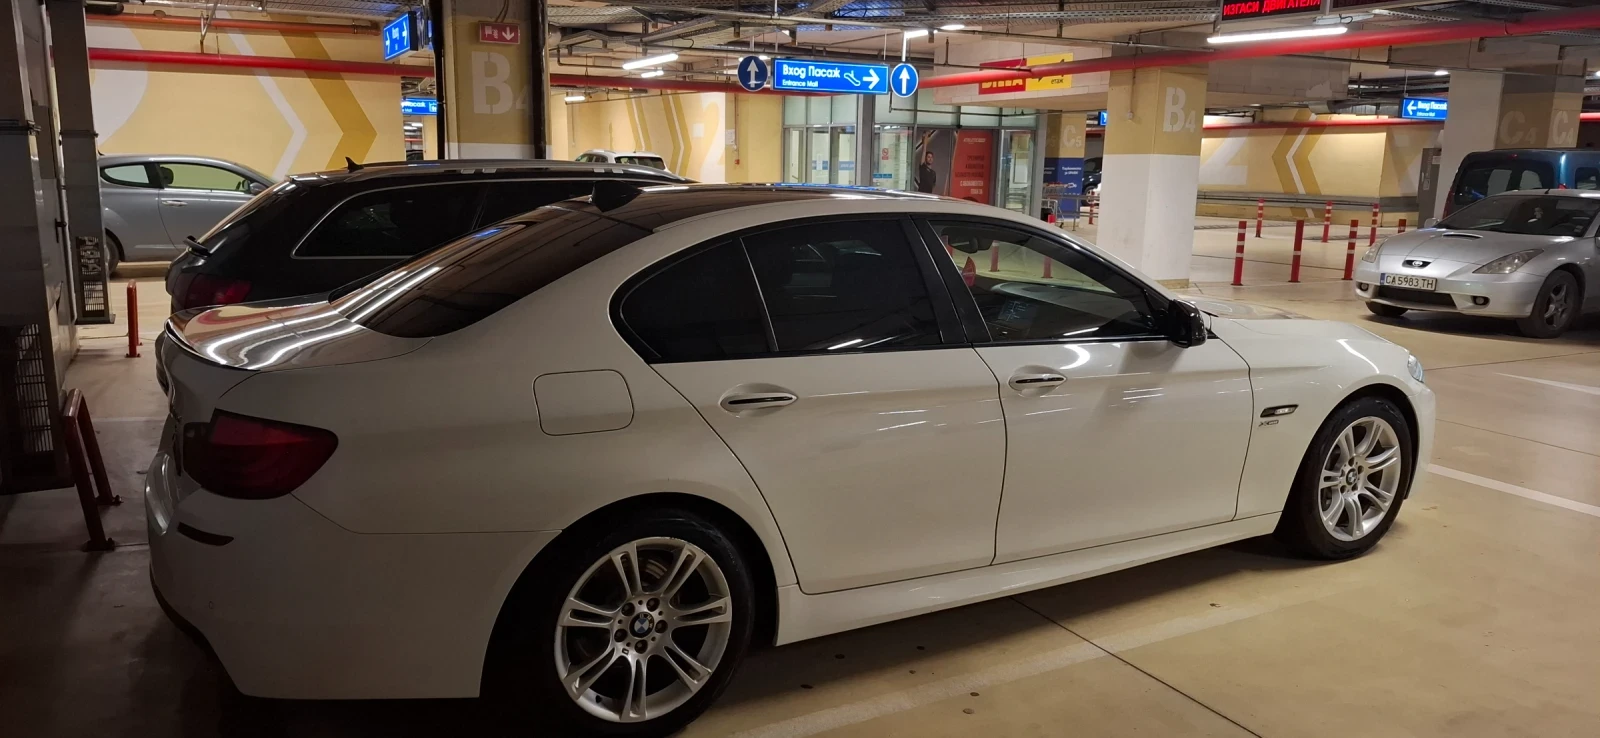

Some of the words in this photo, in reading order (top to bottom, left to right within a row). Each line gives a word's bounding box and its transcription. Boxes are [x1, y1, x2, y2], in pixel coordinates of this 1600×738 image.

[1223, 1, 1259, 16] ИЗГАСИ
[782, 64, 807, 79] Вход
[808, 65, 841, 79] Пасаж
[782, 79, 805, 88] Entrance
[806, 80, 819, 88] Mall
[1385, 275, 1396, 284] CA
[1397, 276, 1419, 287] 5983
[1422, 278, 1434, 289] TH
